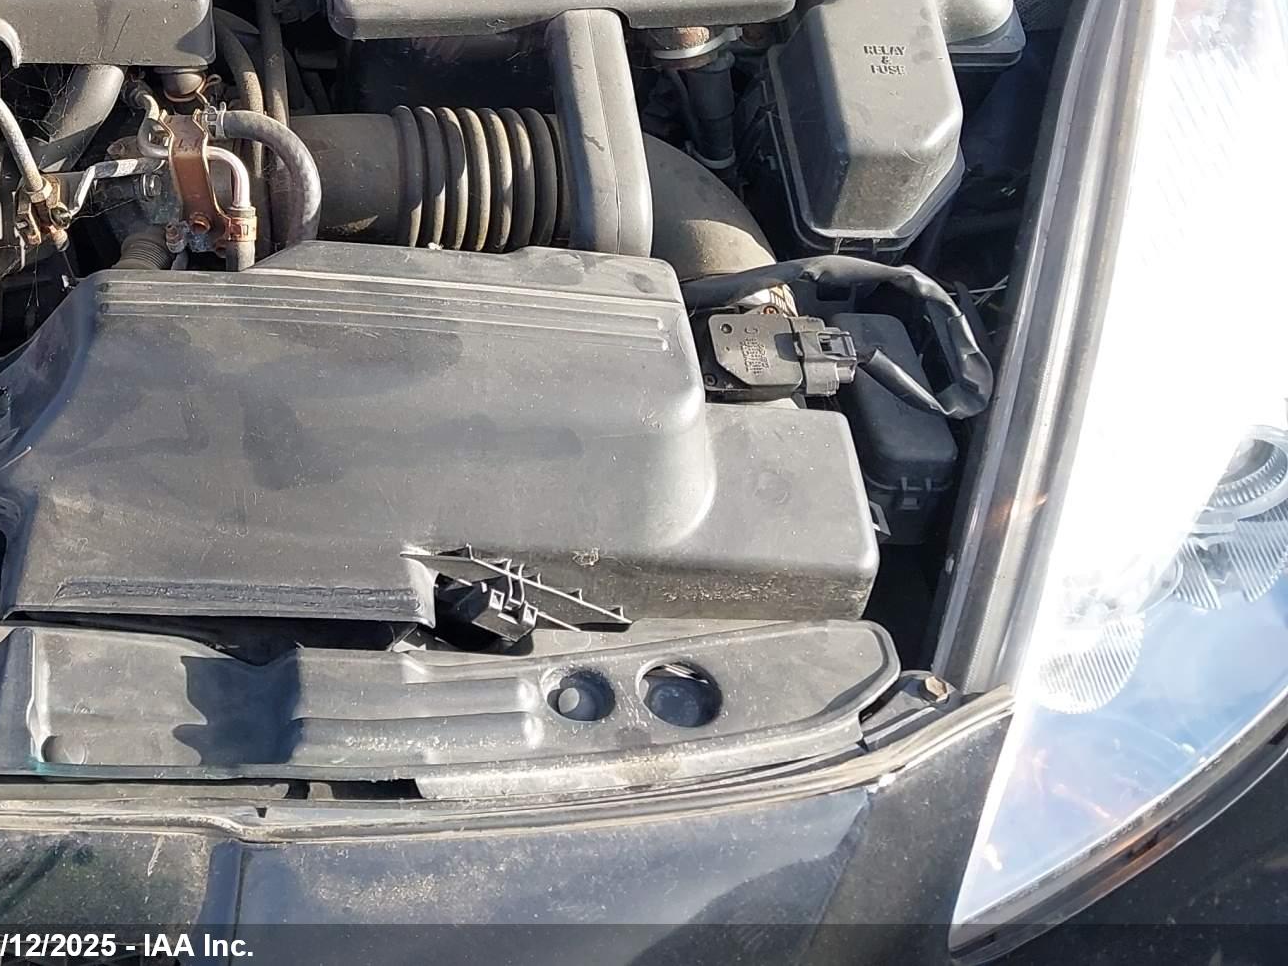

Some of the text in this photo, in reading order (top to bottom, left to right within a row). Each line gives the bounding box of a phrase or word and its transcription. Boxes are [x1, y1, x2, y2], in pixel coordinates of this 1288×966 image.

[863, 44, 906, 57] RELAY
[880, 55, 891, 65] &
[870, 64, 906, 76] FUSE
